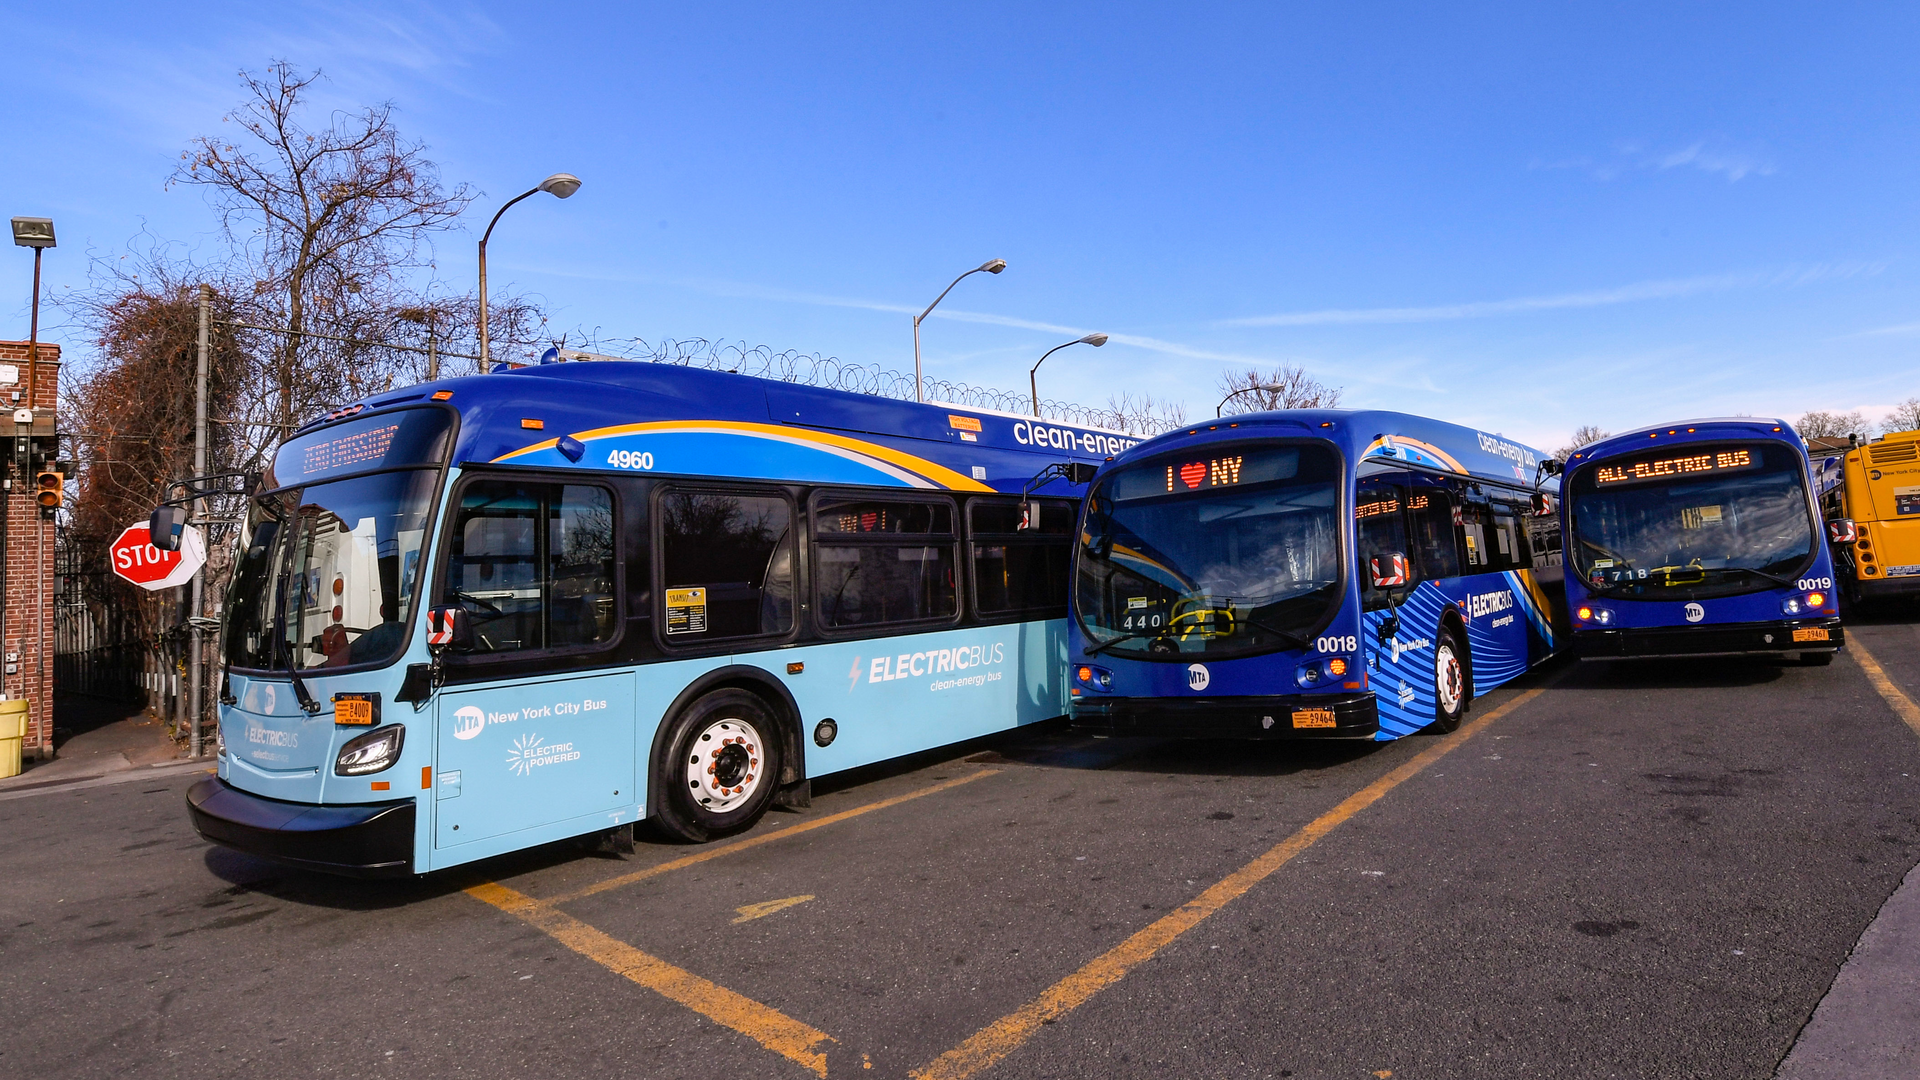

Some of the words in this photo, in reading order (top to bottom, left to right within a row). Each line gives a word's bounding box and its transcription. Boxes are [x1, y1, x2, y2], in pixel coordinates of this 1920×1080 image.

[1014, 420, 1139, 455] clean-ener
[607, 450, 653, 470] 4960
[1598, 455, 1713, 482] ALL-ELECTRIC
[1716, 450, 1750, 468] BUS
[1167, 465, 1173, 492] I
[1211, 455, 1243, 486] NY
[1612, 569, 1647, 582] 718
[1798, 577, 1832, 591] 0019
[1123, 614, 1160, 630] 440
[1317, 636, 1357, 653] 0018
[869, 642, 1004, 684] ELECTRICBUS
[930, 674, 986, 691] clean-energy
[987, 671, 1002, 682] bus
[488, 711, 519, 725] New
[522, 705, 551, 719] York
[554, 702, 580, 716] City
[583, 699, 607, 711] Bus
[249, 727, 299, 748] ELECTRICBUS
[524, 742, 573, 759] ELECTRIC
[530, 751, 580, 768] POWERED
